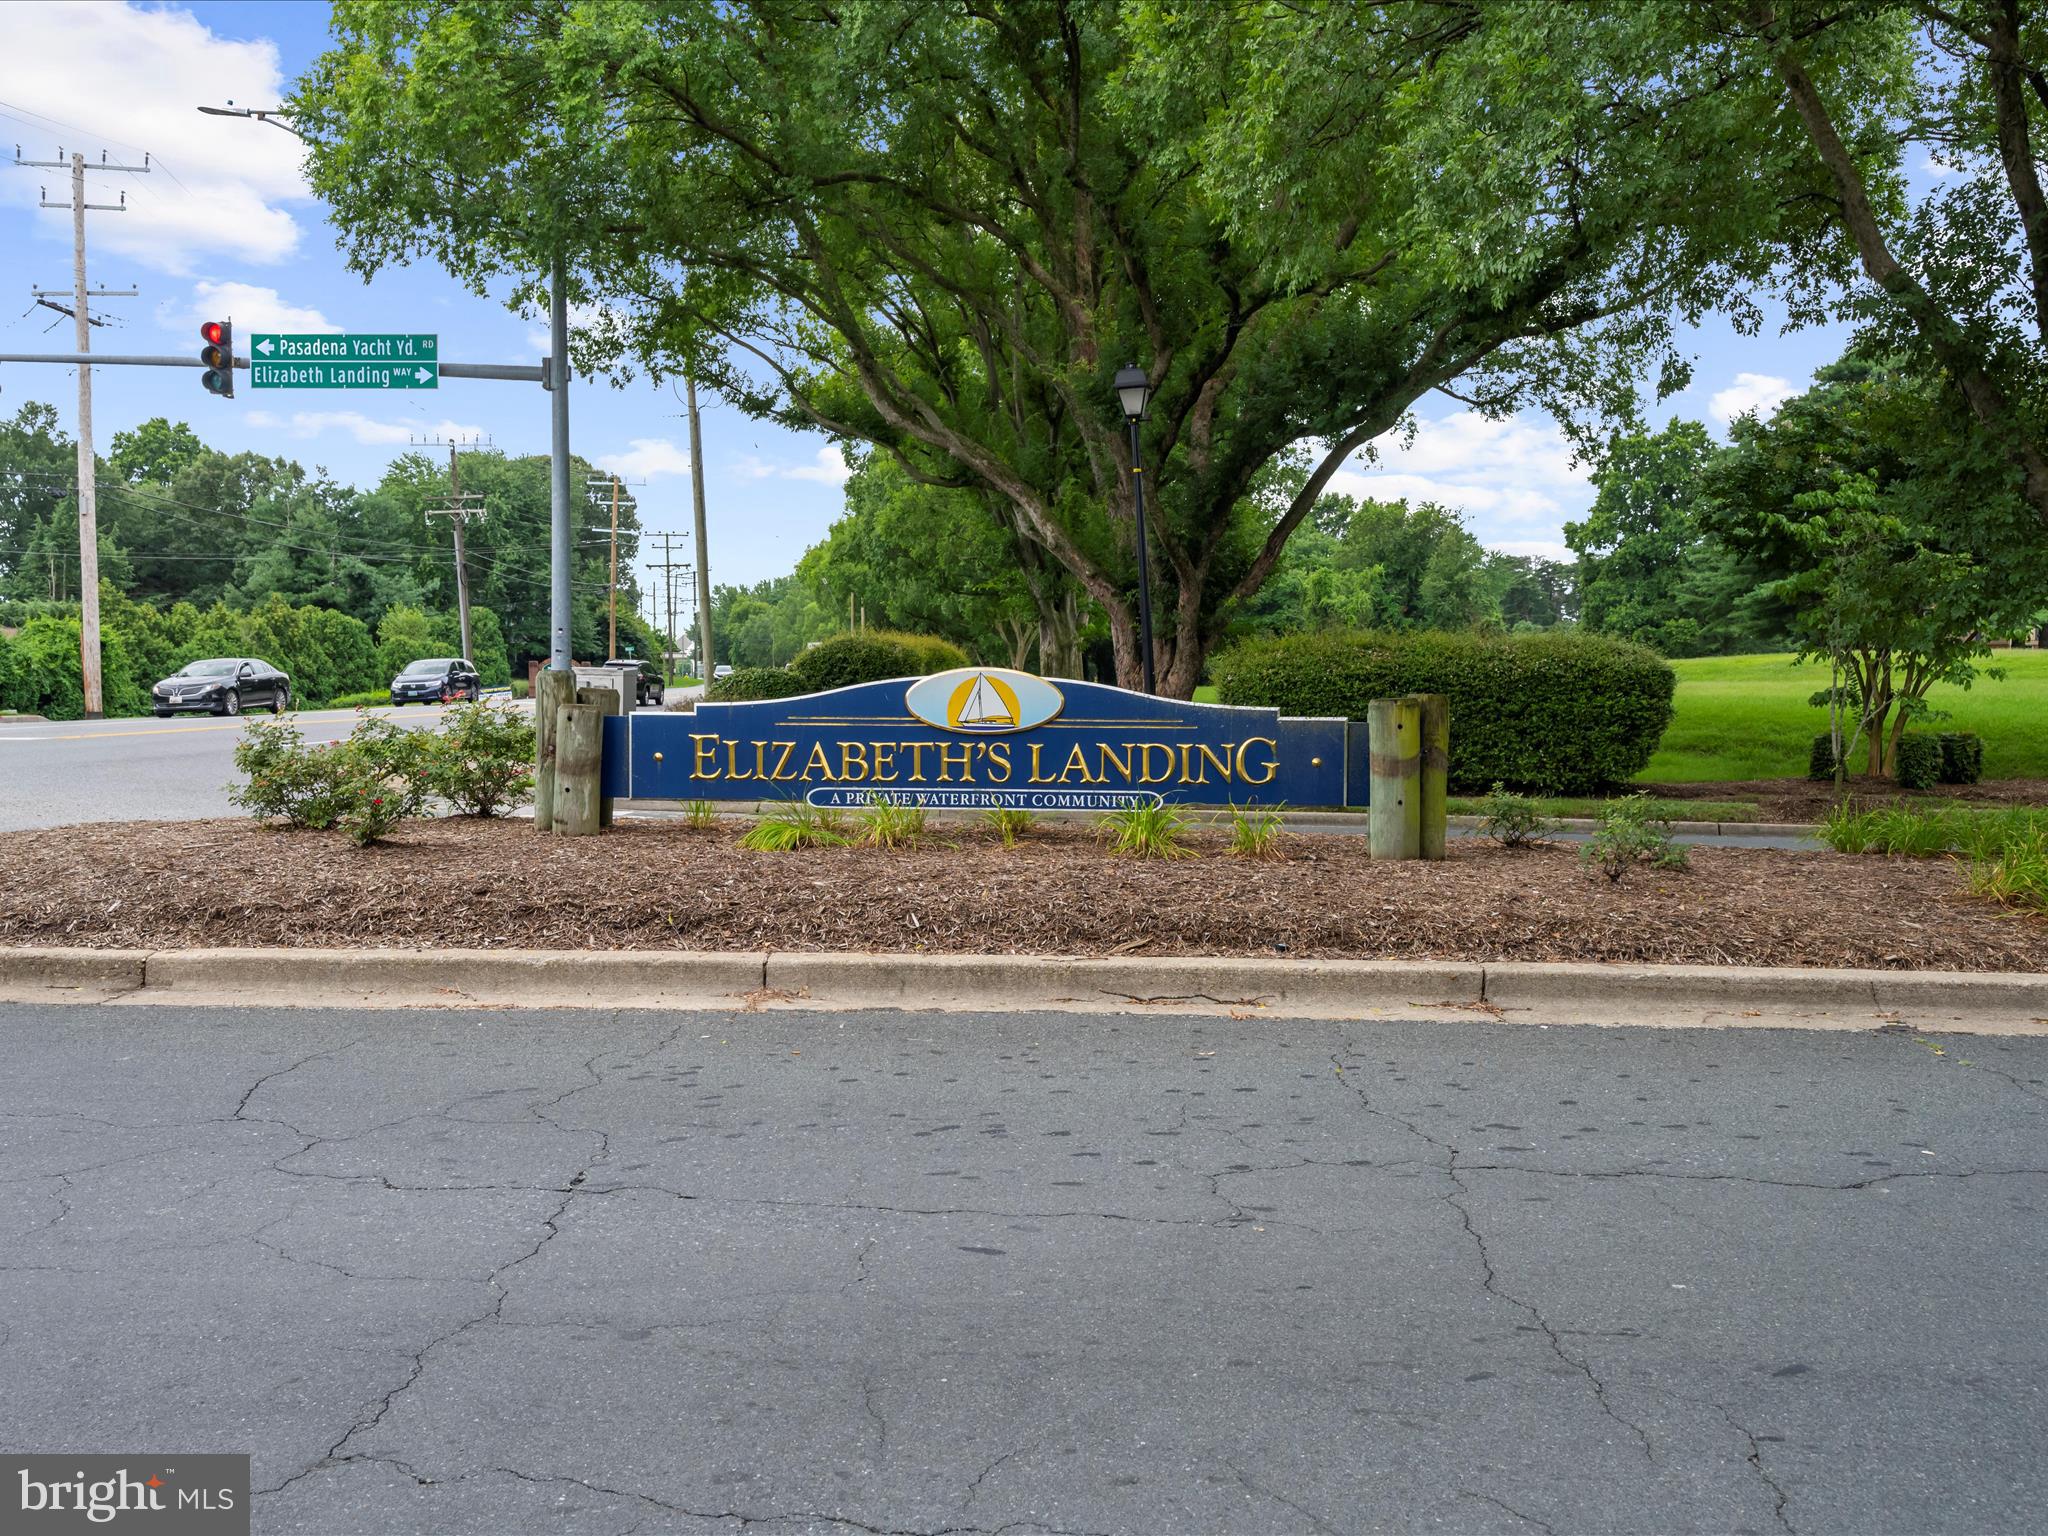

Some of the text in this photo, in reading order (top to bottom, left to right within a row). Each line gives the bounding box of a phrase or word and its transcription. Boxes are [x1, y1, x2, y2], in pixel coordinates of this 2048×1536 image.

[280, 340, 434, 356] Pasadena Yacht Yd. RD
[254, 367, 412, 387] Elizabeth Landing WAY
[1027, 736, 1281, 785] LANDING
[831, 792, 1140, 808] A PRIVATE WATERFRONT COMMUNITY
